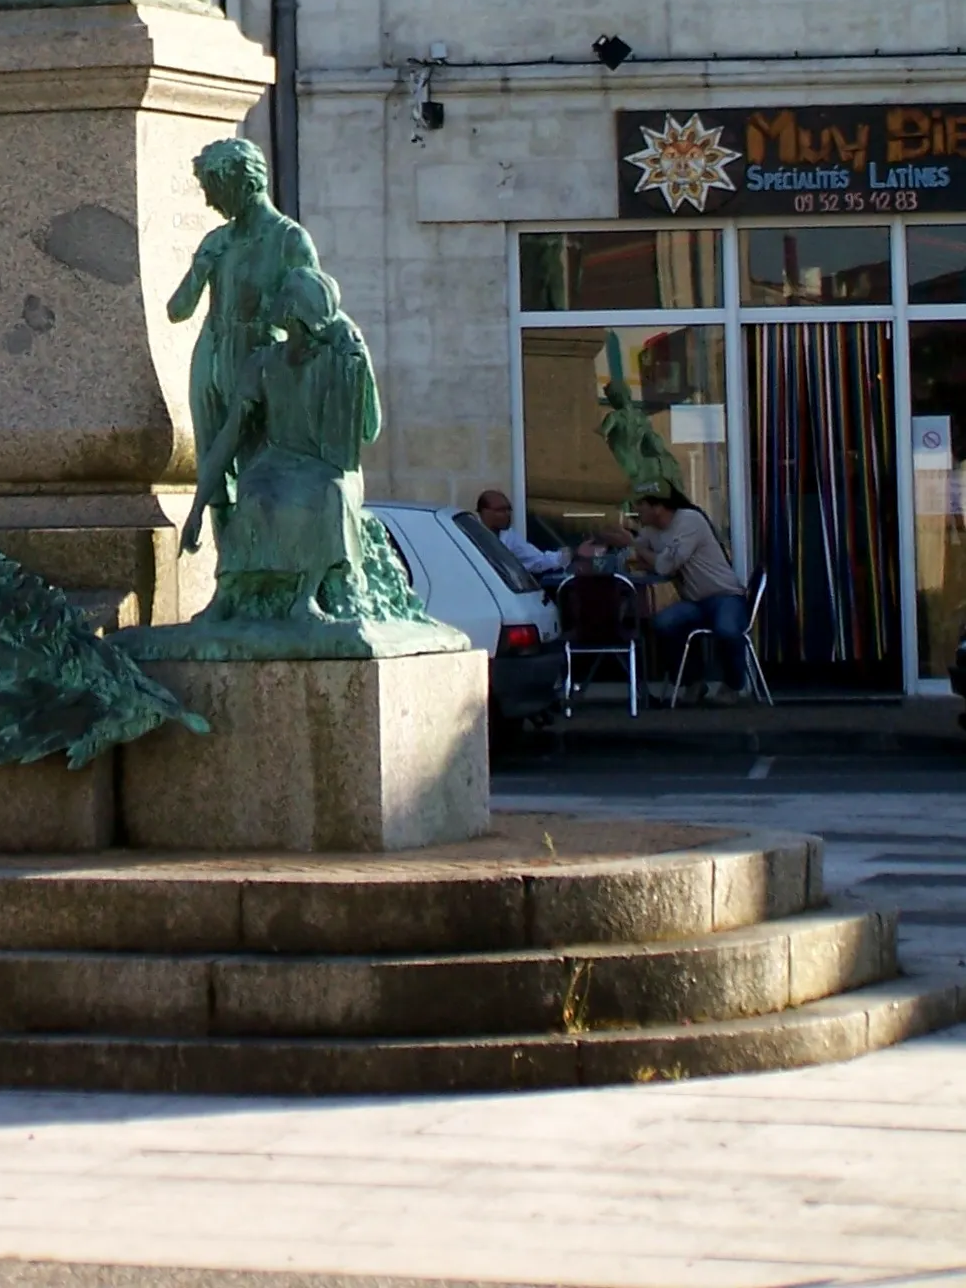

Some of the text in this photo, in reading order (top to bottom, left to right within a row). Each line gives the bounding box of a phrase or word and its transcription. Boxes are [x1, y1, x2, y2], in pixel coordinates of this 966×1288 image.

[869, 161, 951, 189] LATINES
[794, 193, 814, 212] 09
[818, 192, 840, 211] 52
[844, 192, 865, 211] 95
[895, 190, 918, 211] 83
